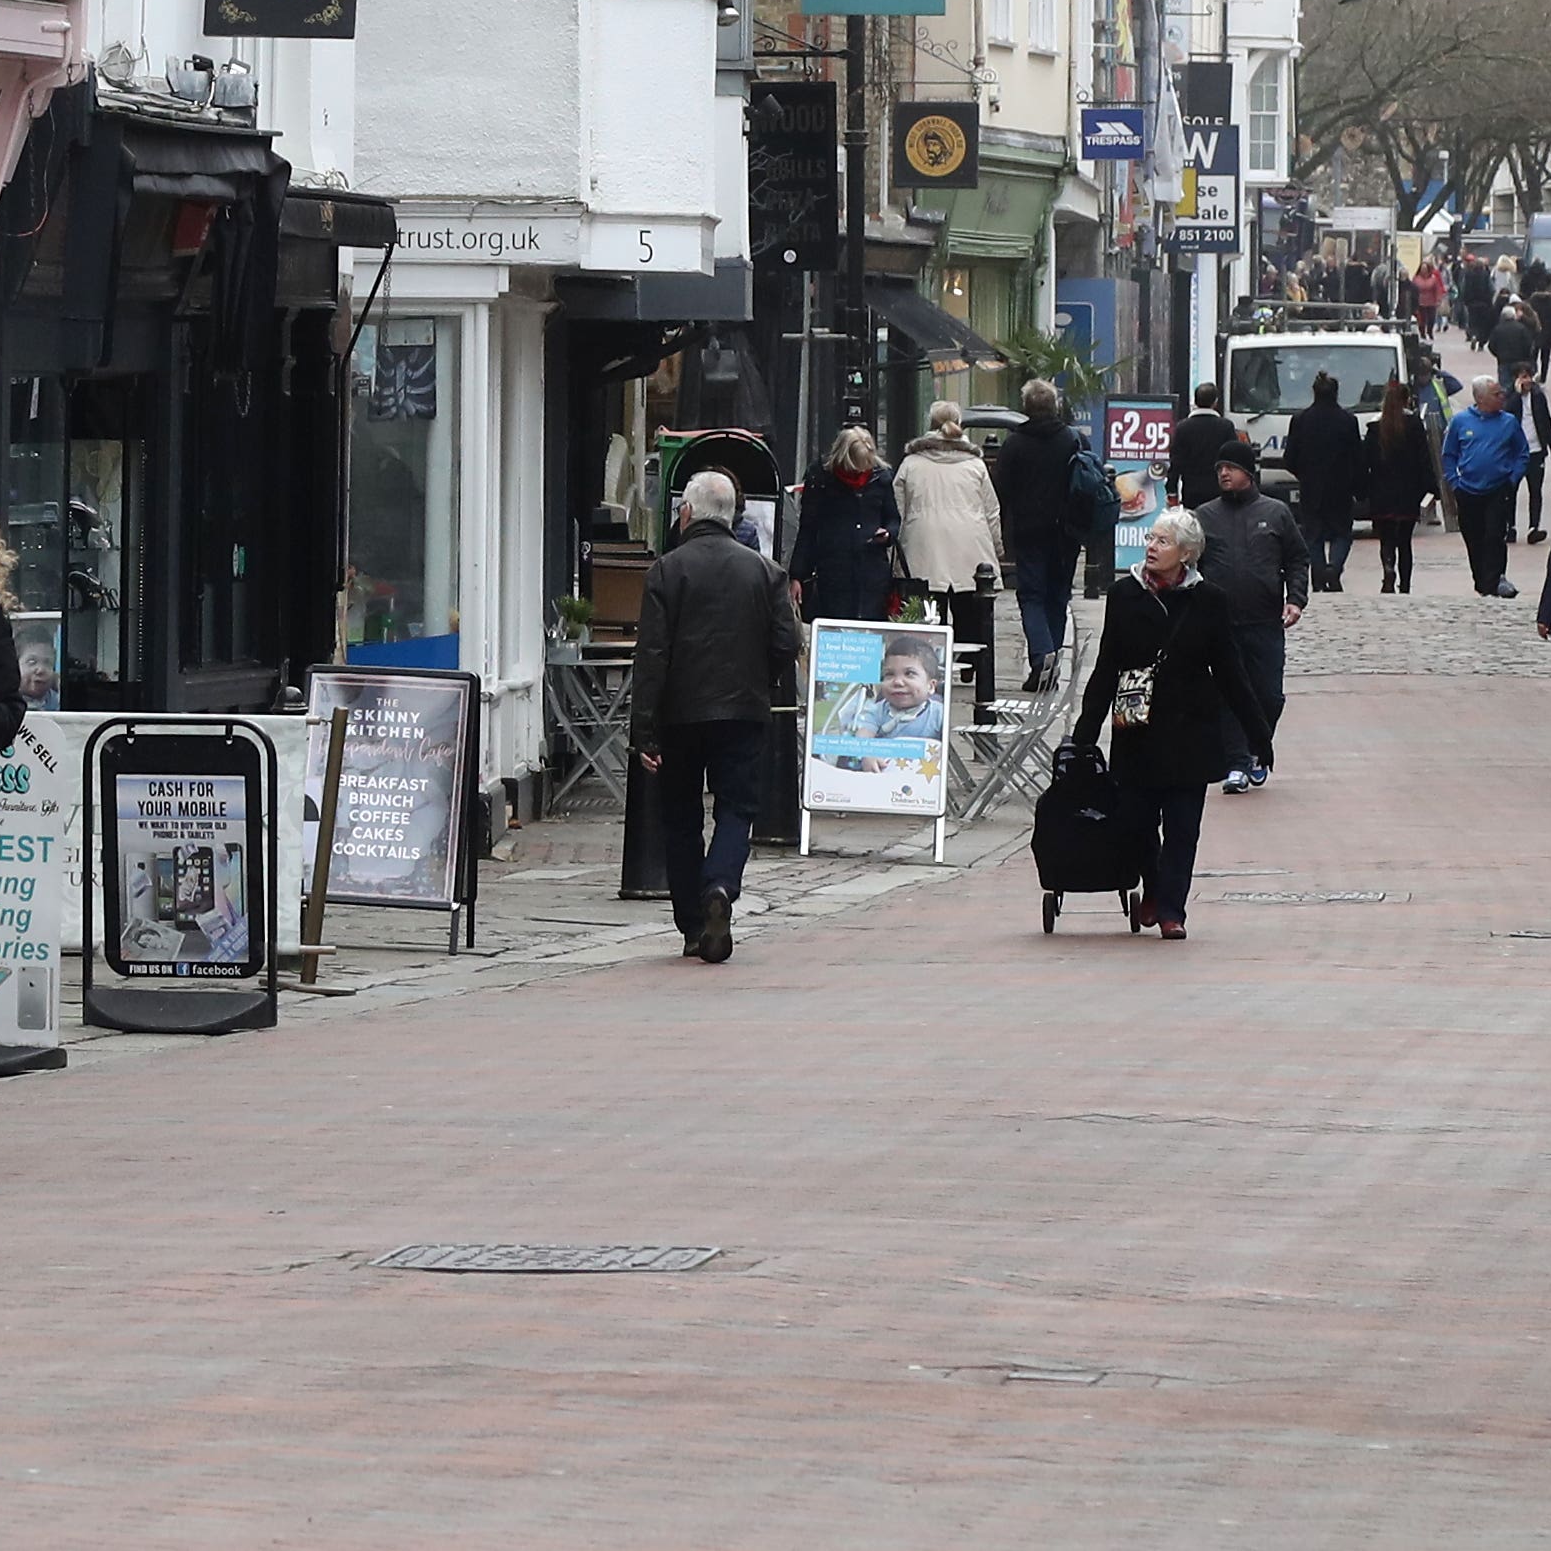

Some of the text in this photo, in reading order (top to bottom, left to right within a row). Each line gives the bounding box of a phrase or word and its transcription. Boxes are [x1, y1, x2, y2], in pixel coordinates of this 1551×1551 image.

[1085, 135, 1142, 147] TRESPASS
[397, 225, 540, 256] trust.org.uk
[1179, 230, 1234, 242] 851 2100
[638, 230, 653, 263] 5
[1110, 411, 1170, 451] £2.95
[376, 698, 399, 707] THE
[354, 709, 421, 724] SKINNY
[347, 724, 424, 739] KITCHEN
[18, 725, 59, 775] WE SELL
[149, 781, 214, 798] CASH FOR
[339, 774, 428, 791] BREAKFAST
[349, 792, 413, 808] BRUNCH
[137, 801, 227, 817] YOUR MOBILE
[350, 809, 410, 825] COFFEE
[138, 822, 227, 831] WE WANT TO BUY YOUR OLD
[352, 827, 404, 841] CAKES
[153, 831, 178, 840] PHONES
[187, 831, 215, 840] TABLETS
[332, 842, 421, 860] COCKTAILS
[129, 965, 241, 976] FIND US ON facebook
